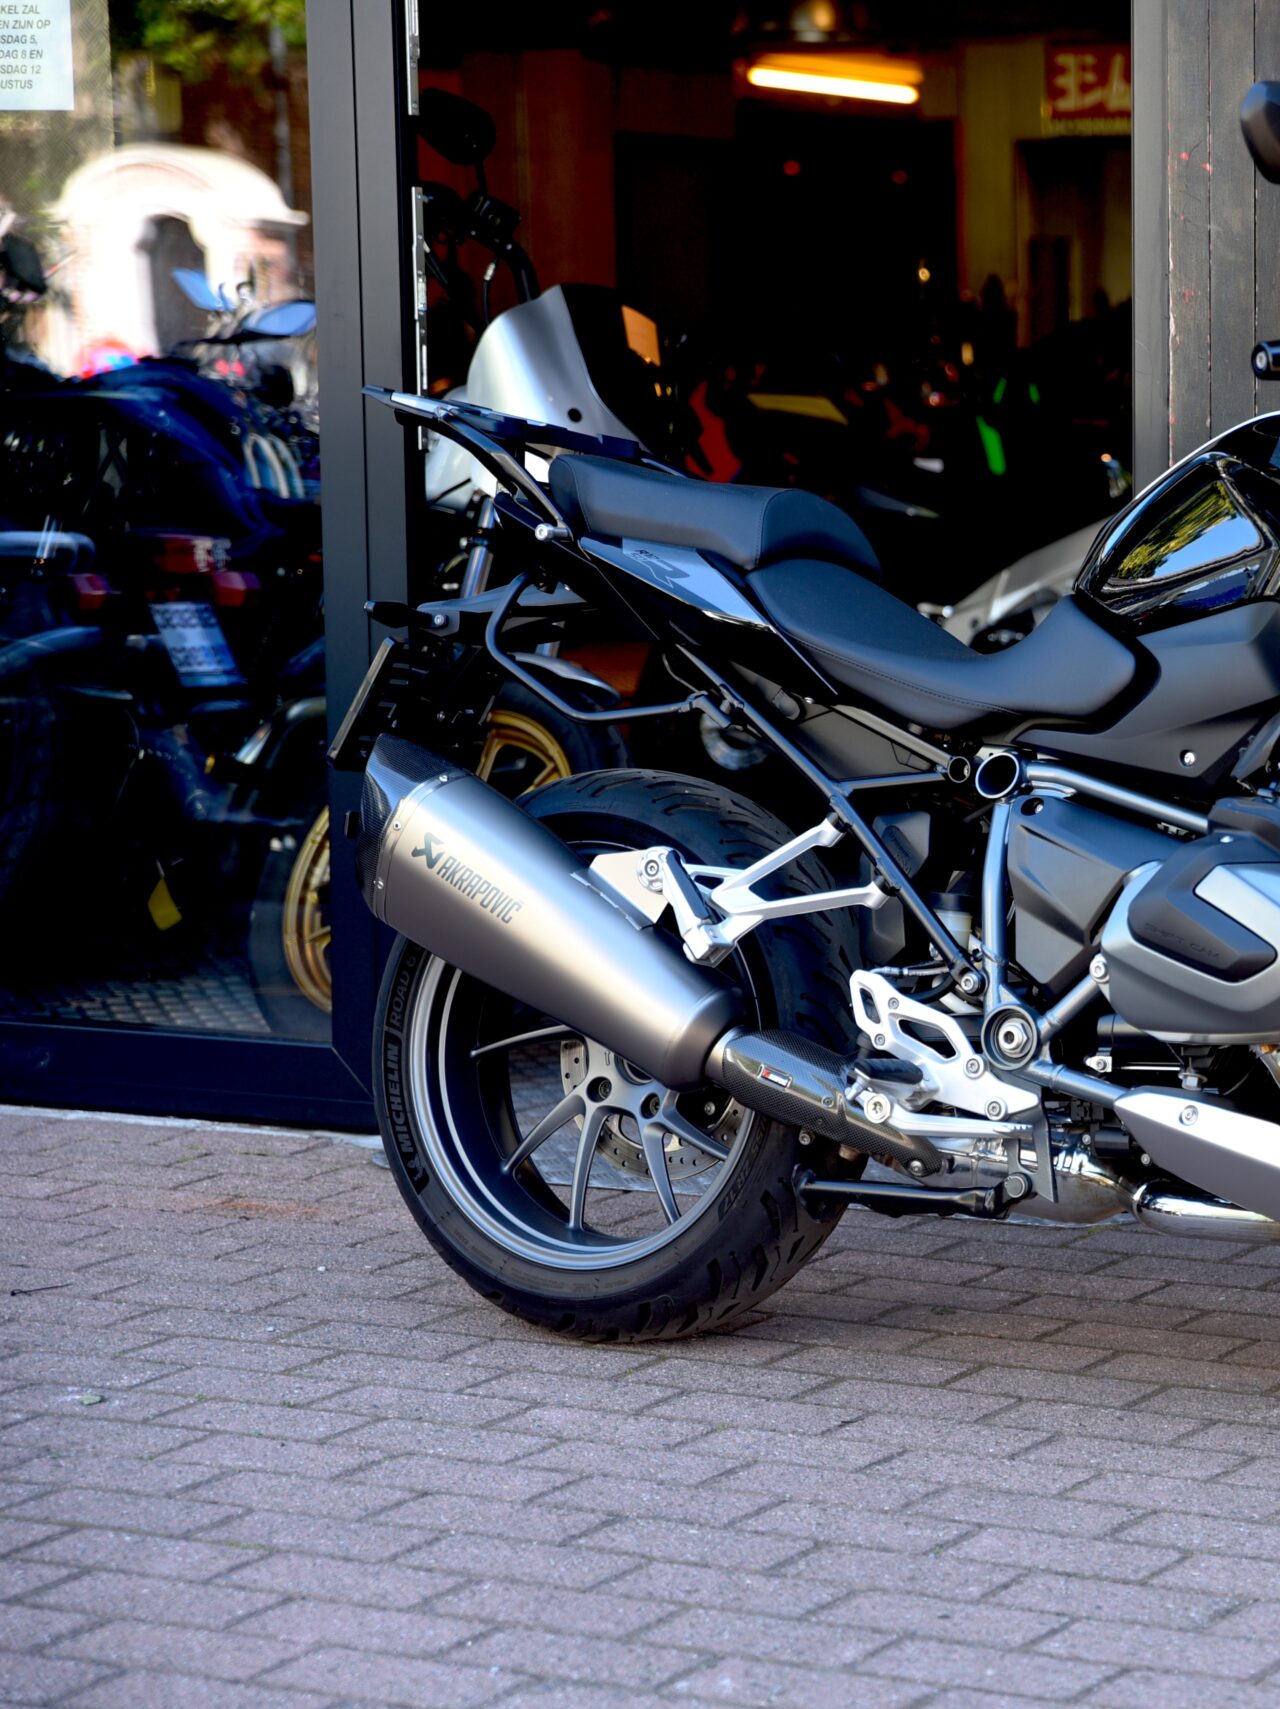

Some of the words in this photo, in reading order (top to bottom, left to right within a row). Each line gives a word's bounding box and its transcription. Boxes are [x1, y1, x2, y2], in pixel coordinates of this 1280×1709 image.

[22, 5, 40, 14] ZAL
[12, 20, 33, 29] ZIJN
[36, 20, 51, 29] OP
[0, 35, 27, 44] SDAG
[30, 35, 38, 45] 5,
[21, 49, 27, 59] 8
[30, 50, 43, 59] EN
[0, 65, 27, 74] SDAG
[31, 65, 41, 74] 12
[390, 970, 411, 1026] ROAD
[387, 1043, 414, 1152] MICHELIN
